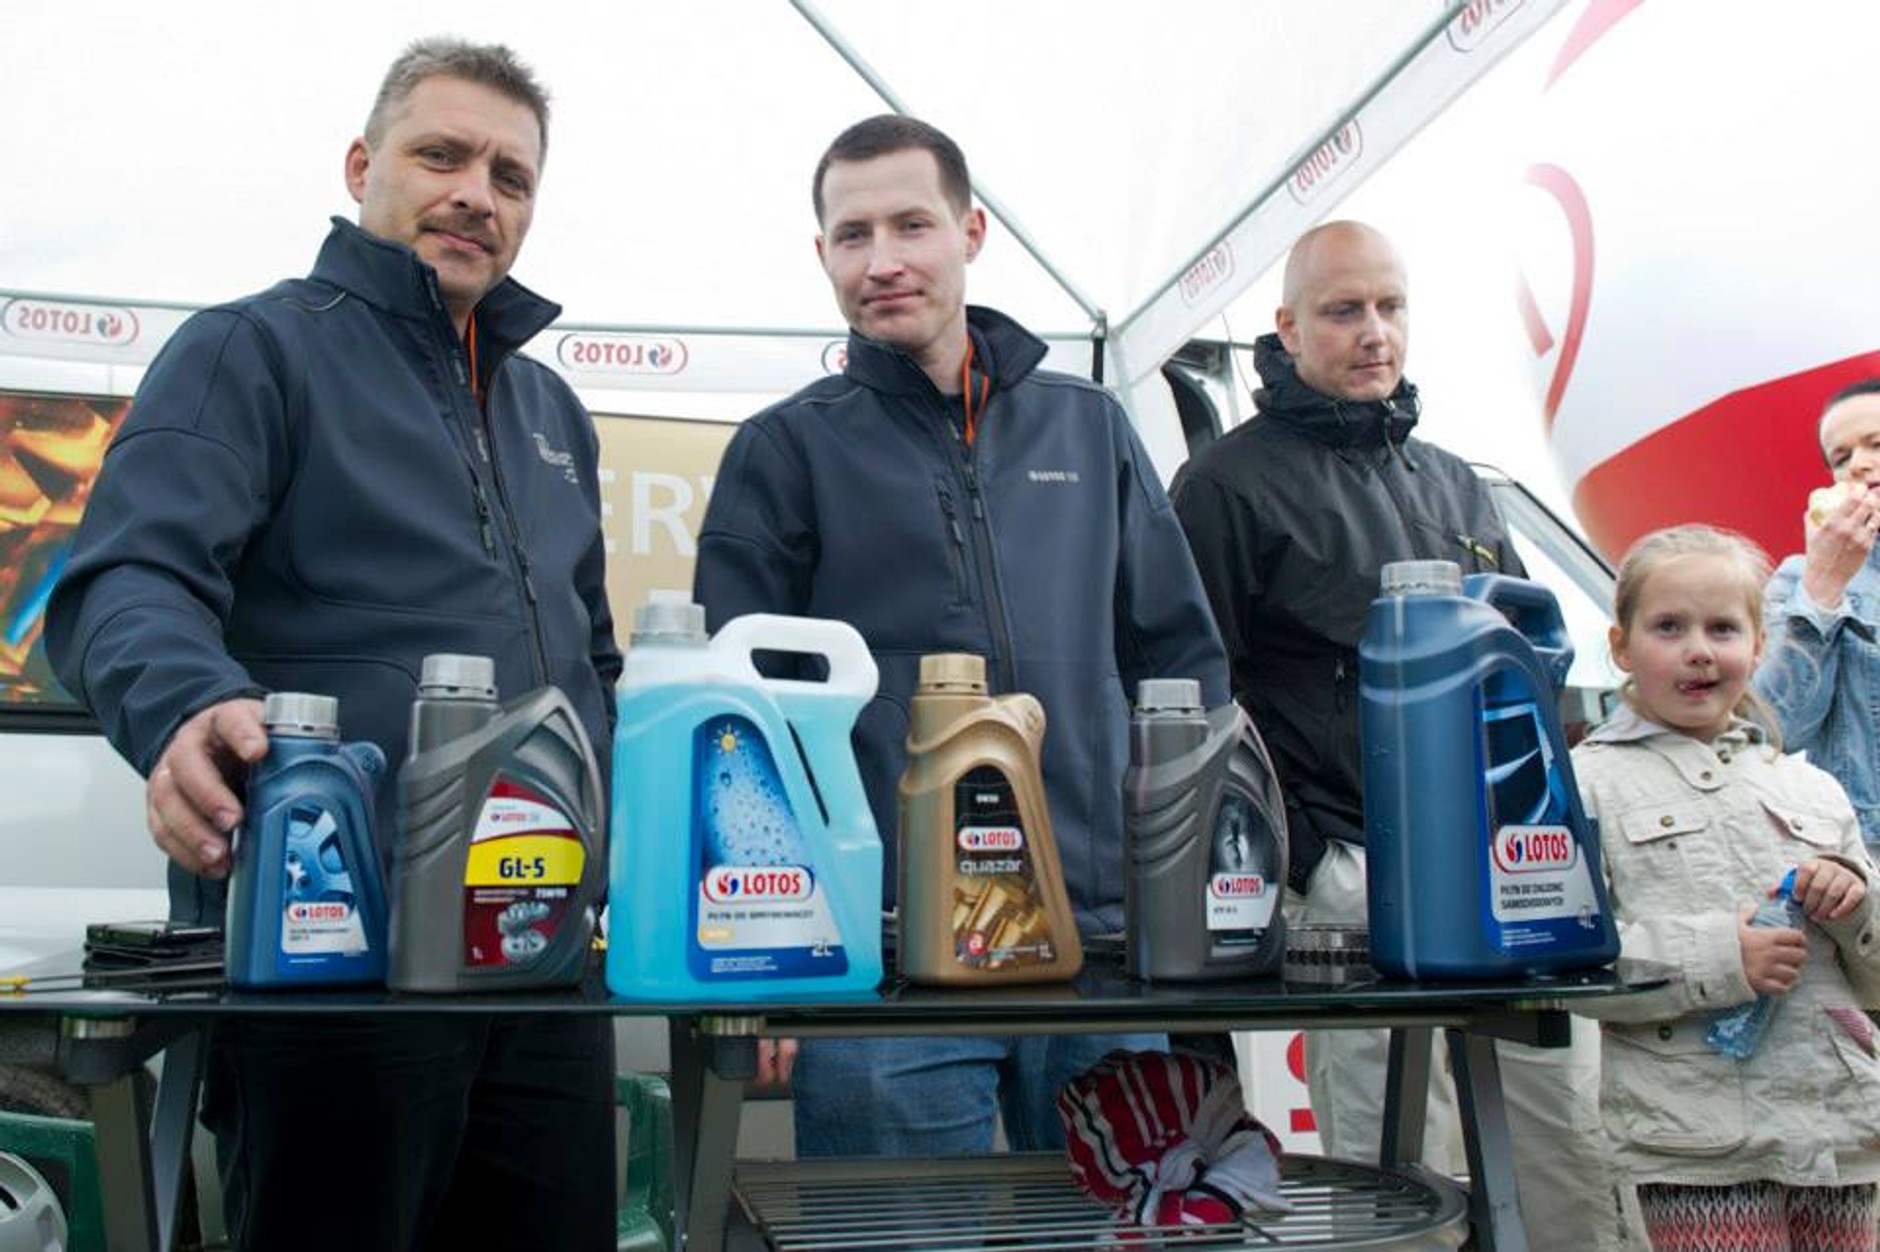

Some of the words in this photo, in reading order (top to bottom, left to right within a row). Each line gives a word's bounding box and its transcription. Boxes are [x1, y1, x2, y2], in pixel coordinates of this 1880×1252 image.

[982, 831, 1016, 846] LOTOS
[1524, 833, 1568, 862] LOTOS
[499, 857, 545, 879] GL-5
[960, 860, 1022, 875] quazar
[743, 873, 800, 895] LOTOS
[1231, 877, 1260, 895] LOTOS
[309, 906, 344, 919] LOTOS
